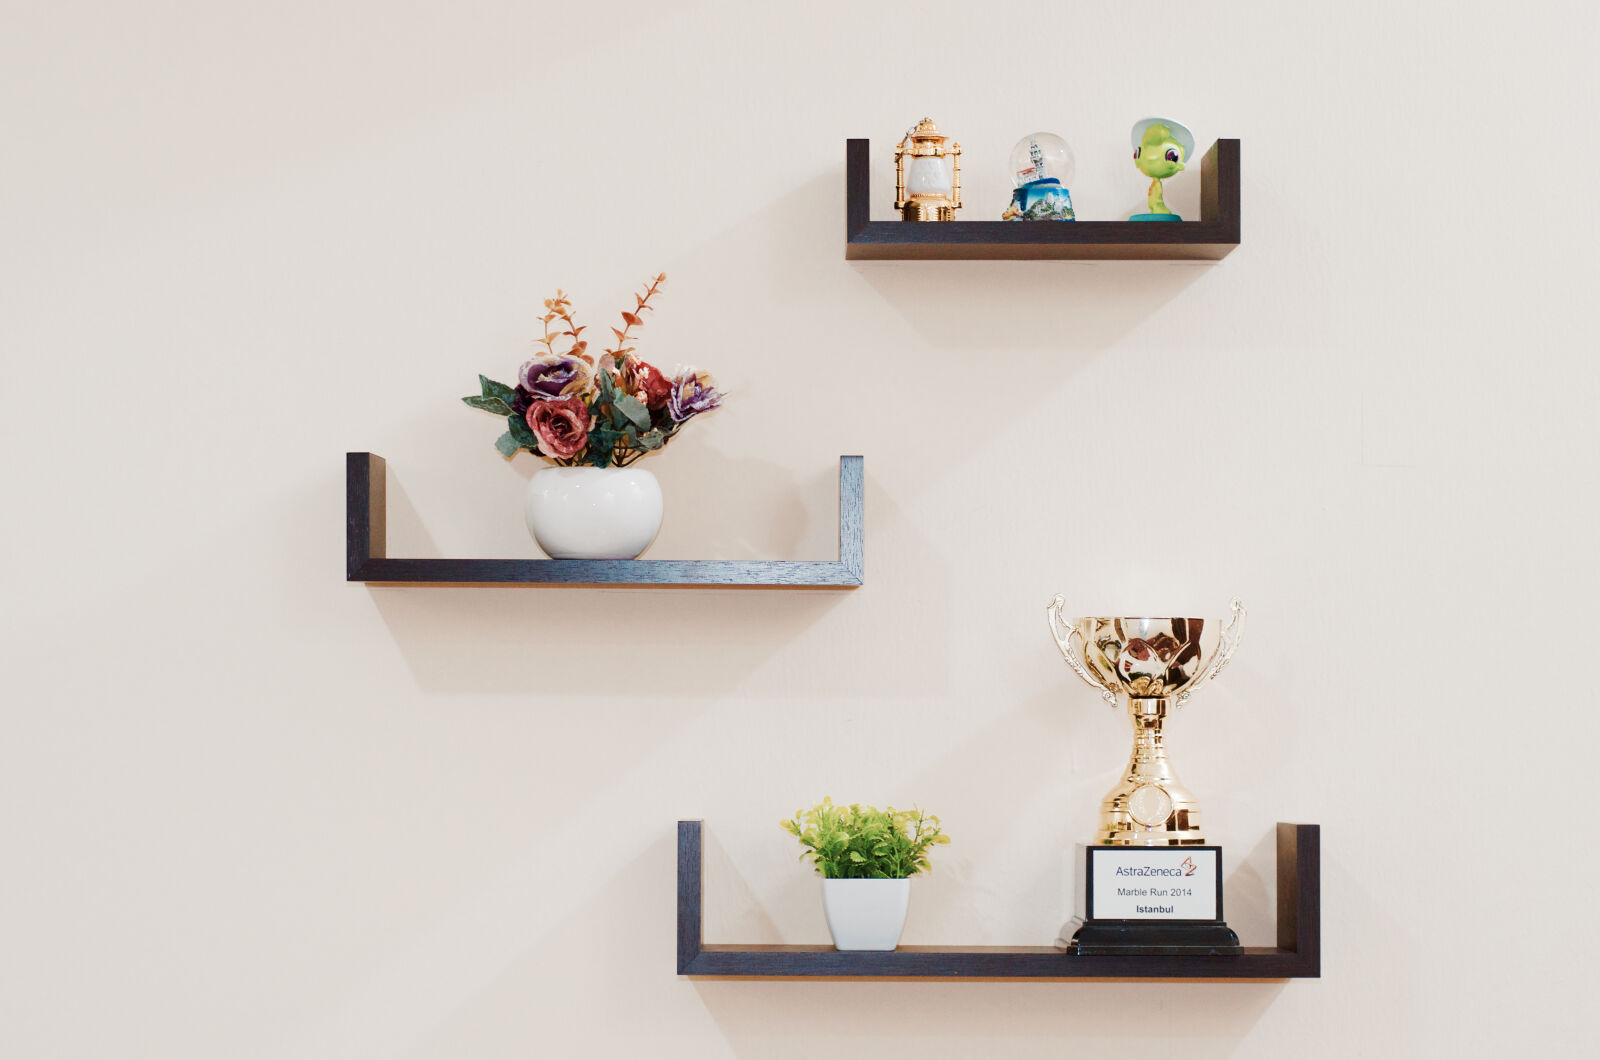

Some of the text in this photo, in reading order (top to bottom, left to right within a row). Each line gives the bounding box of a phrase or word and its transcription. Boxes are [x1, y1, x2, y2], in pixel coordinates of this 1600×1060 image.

[1115, 866, 1182, 877] AstraZeneca
[1117, 887, 1192, 897] Marble Run 2014
[1136, 904, 1174, 914] Istanbul
